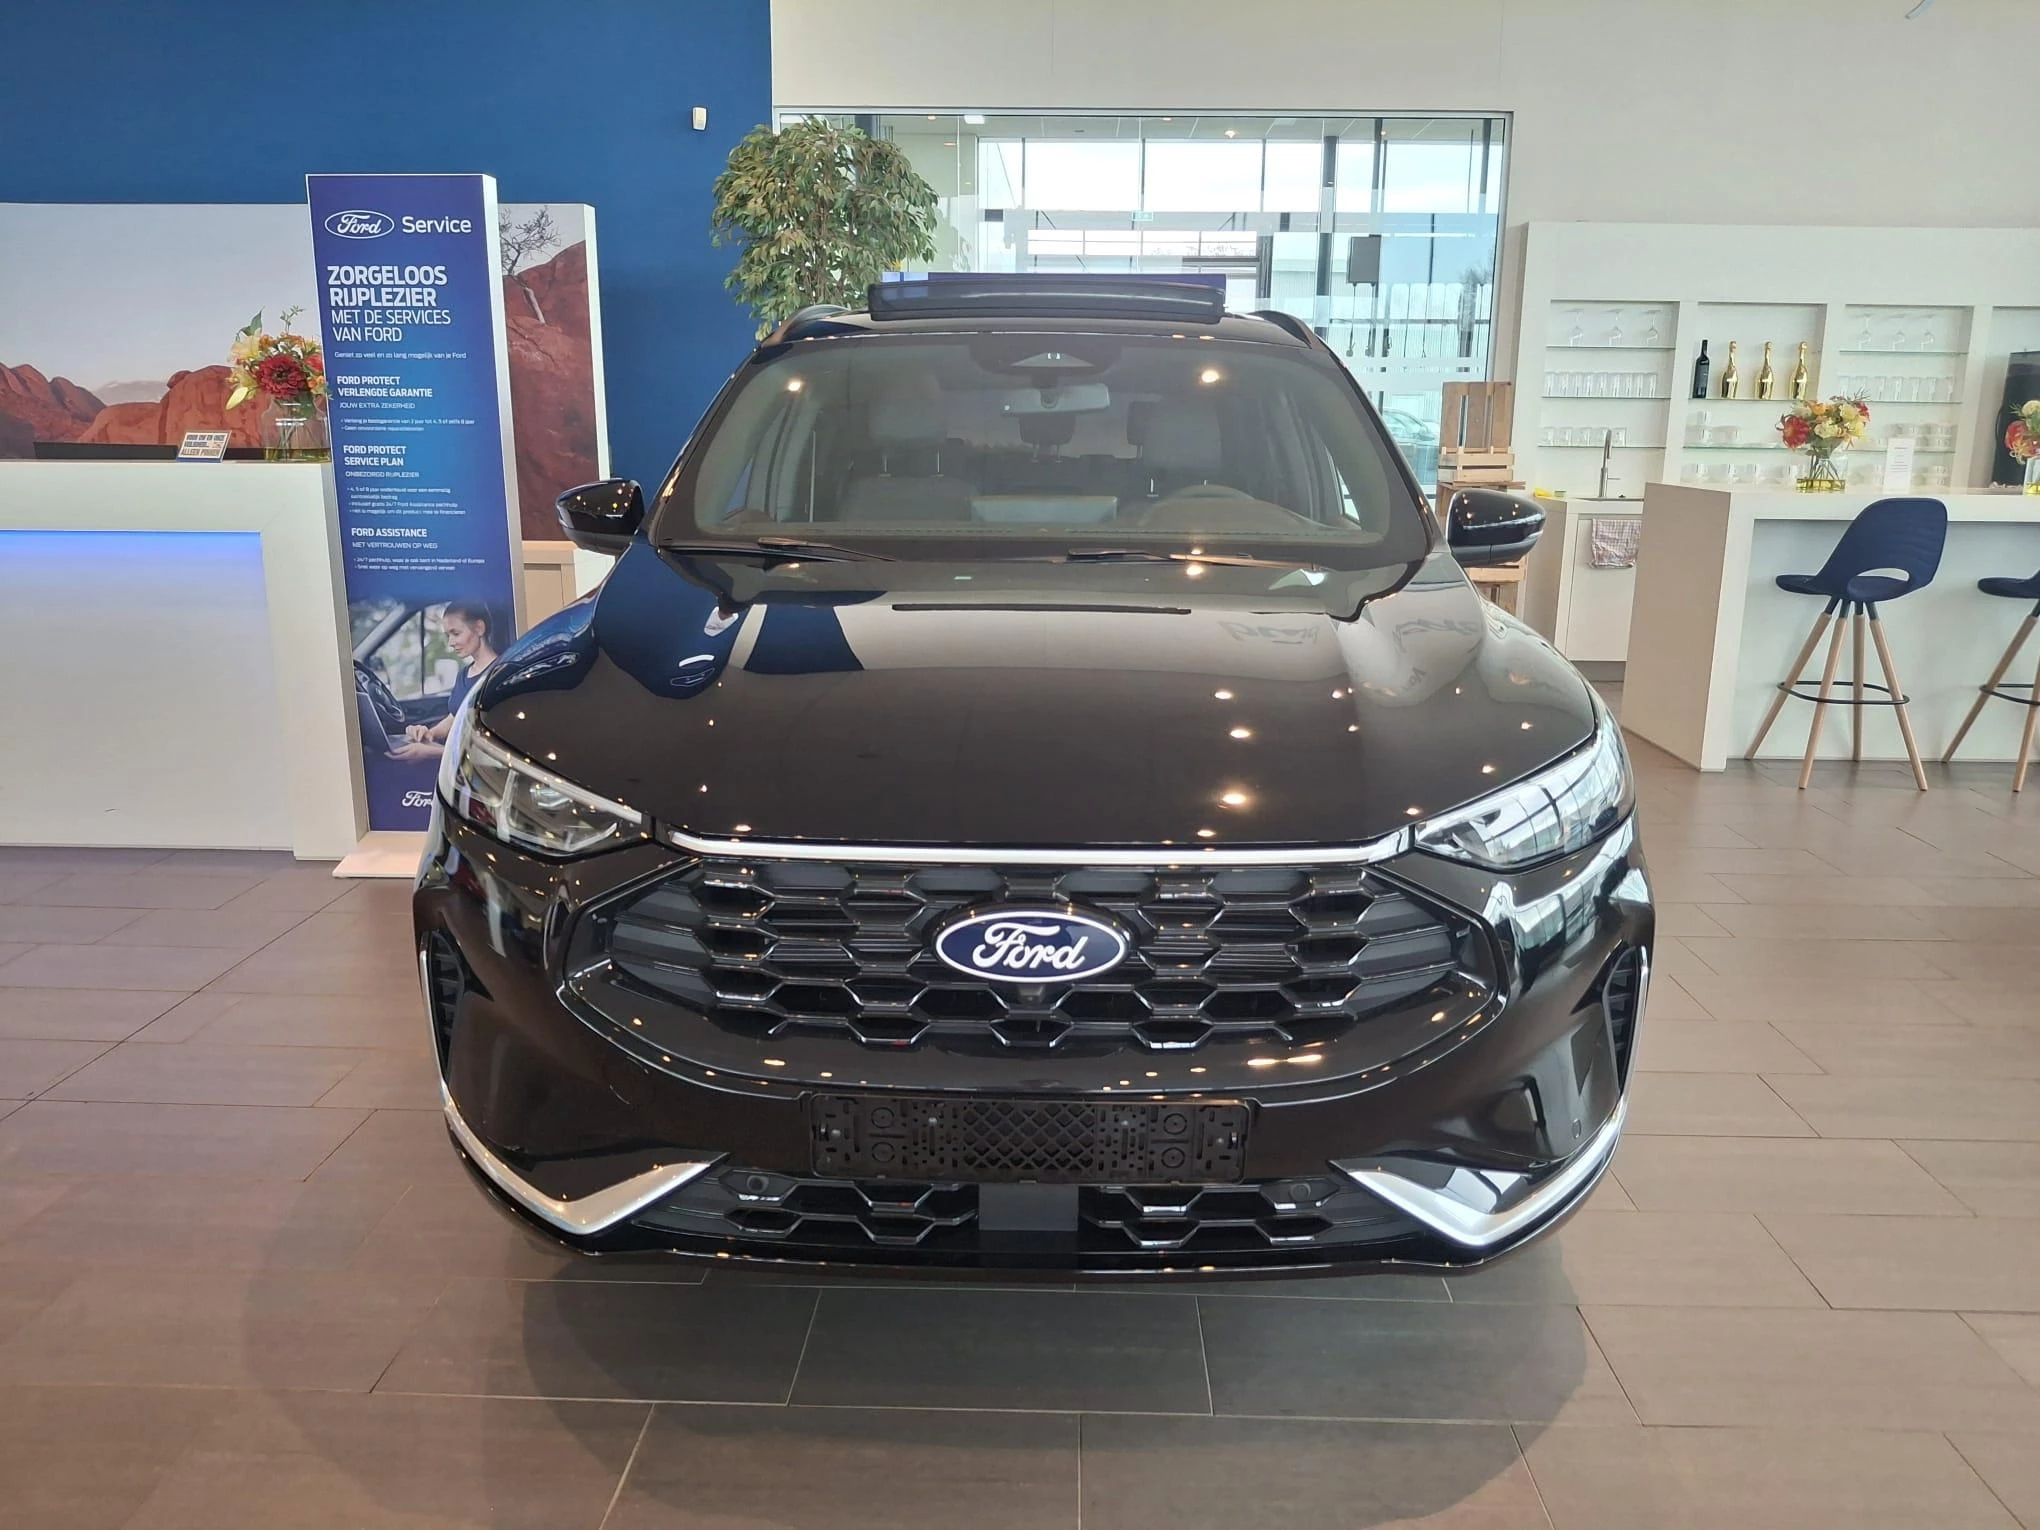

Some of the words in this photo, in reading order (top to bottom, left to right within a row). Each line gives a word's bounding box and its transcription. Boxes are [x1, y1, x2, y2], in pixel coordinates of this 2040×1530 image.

[337, 214, 381, 234] Ford
[402, 216, 472, 233] Service
[327, 266, 448, 285] ZORGELOOS
[330, 288, 437, 306] RIJPLEZIER
[332, 310, 360, 324] MET
[365, 310, 382, 324] DE
[386, 310, 451, 324] SERVICES
[332, 327, 361, 342] VAN
[365, 327, 402, 342] FORD
[337, 376, 360, 385] FORD
[362, 376, 400, 385] PROTECT
[338, 388, 388, 397] VERLENGDE
[390, 388, 432, 397] GARANTIE
[343, 445, 366, 454] FORD
[368, 445, 406, 454] PROTECT
[344, 457, 379, 466] SERVICE
[380, 457, 404, 466] PLAN
[351, 528, 374, 537] FORD
[376, 528, 427, 537] ASSISTANCE
[402, 791, 433, 808] For
[972, 922, 1088, 969] Ford
